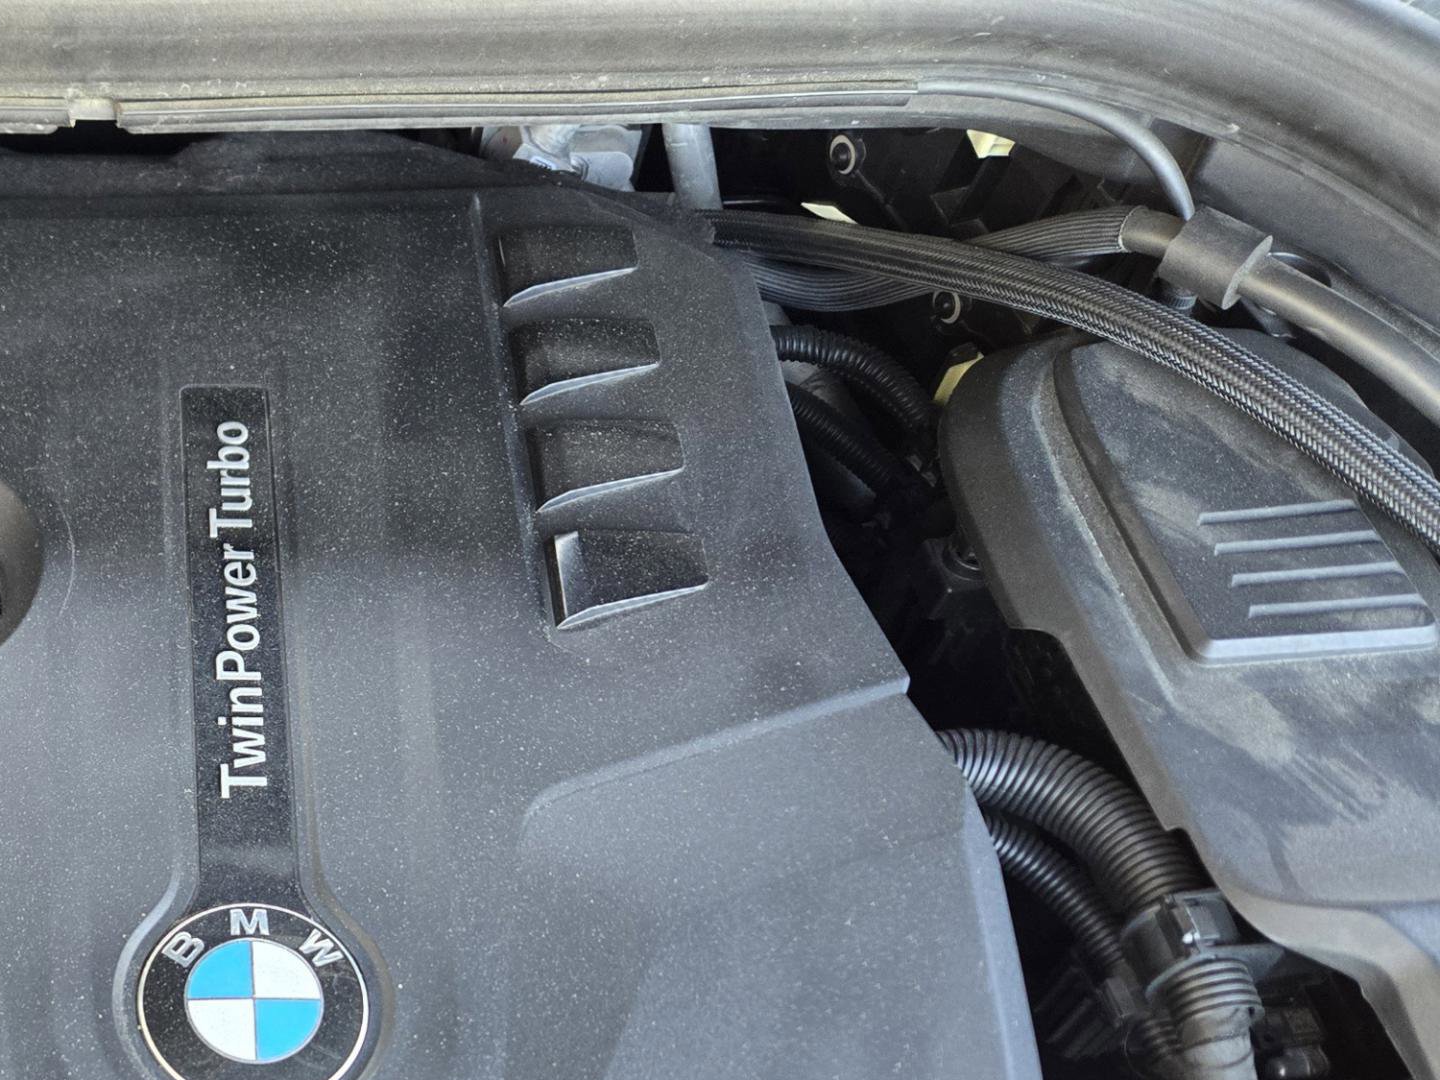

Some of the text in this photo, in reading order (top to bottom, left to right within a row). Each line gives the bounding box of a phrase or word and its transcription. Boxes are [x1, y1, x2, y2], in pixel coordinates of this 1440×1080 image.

[206, 420, 268, 799] TwinPower Turbo
[161, 908, 344, 969] BMW
